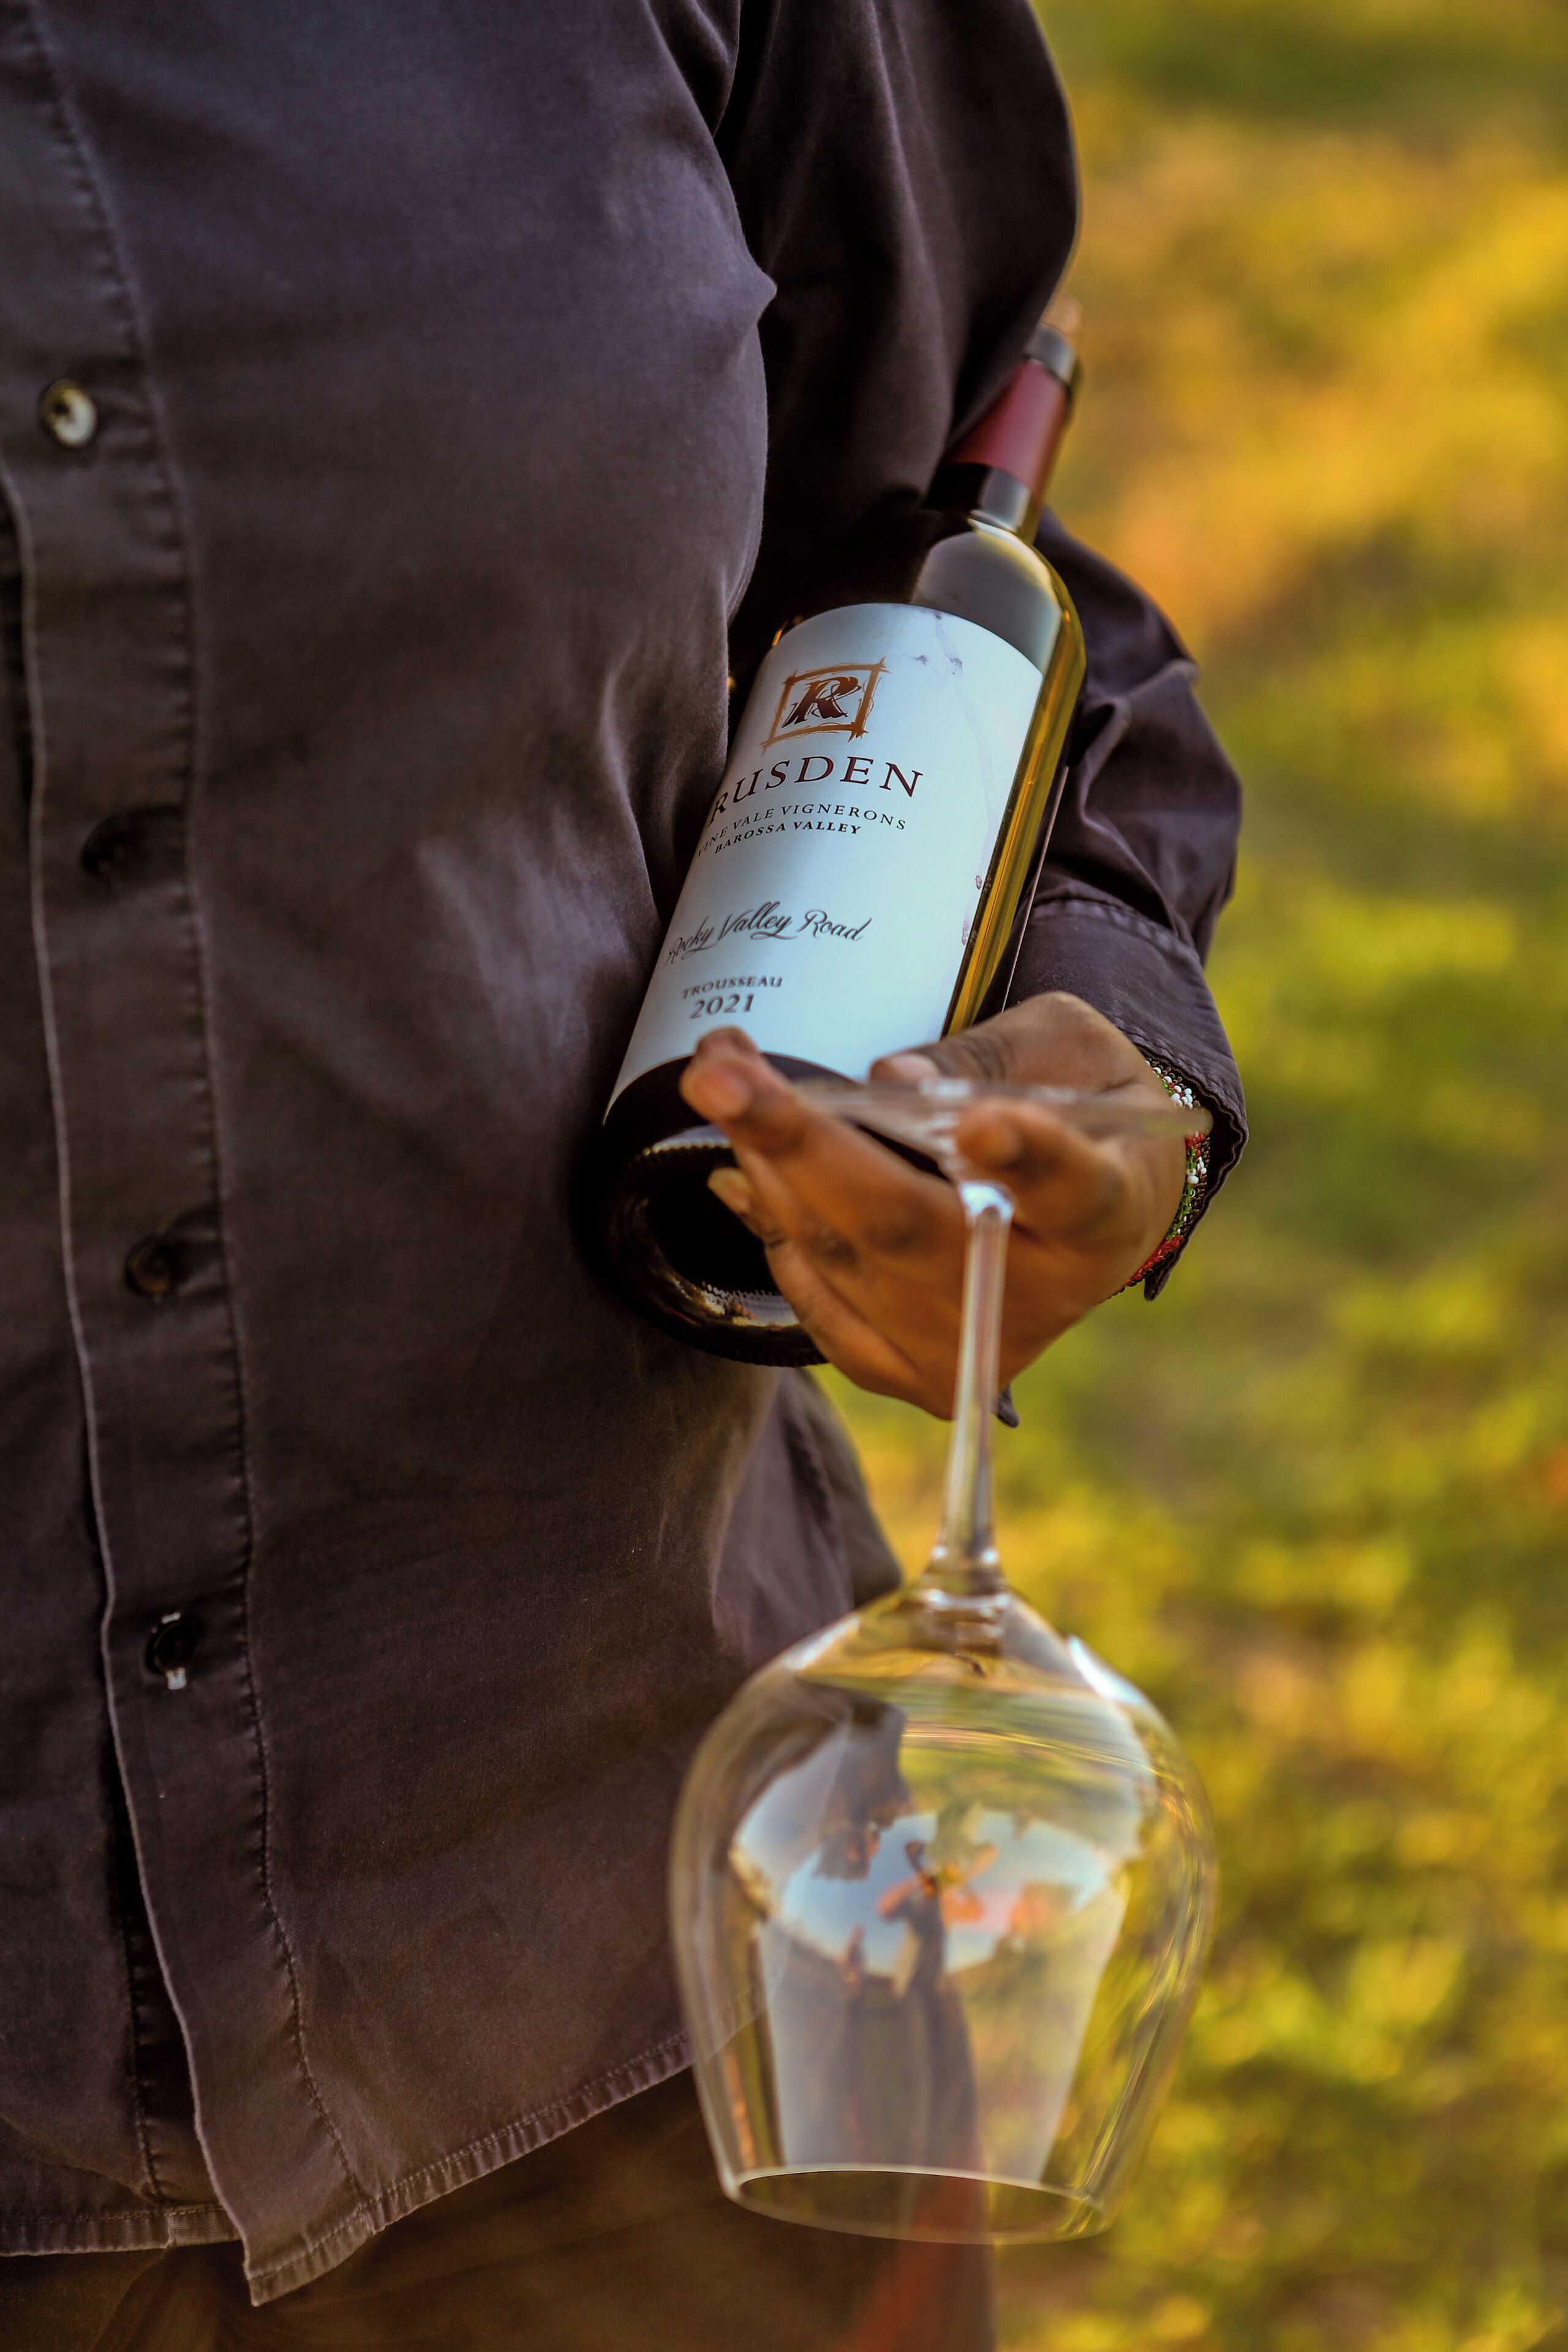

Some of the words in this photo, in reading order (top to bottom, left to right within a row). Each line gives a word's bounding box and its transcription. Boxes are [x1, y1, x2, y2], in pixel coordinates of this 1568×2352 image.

[708, 756, 924, 827] RUSDEN
[733, 809, 775, 830] VALE
[781, 804, 907, 831] VIGNERONS
[714, 823, 787, 854] BAROSSA
[793, 821, 862, 835] VALLEY
[662, 916, 717, 970] Rocky
[718, 901, 794, 941] Valley
[796, 909, 872, 941] Road
[682, 976, 783, 999] TROUSSEAU
[690, 993, 755, 1019] 2021
